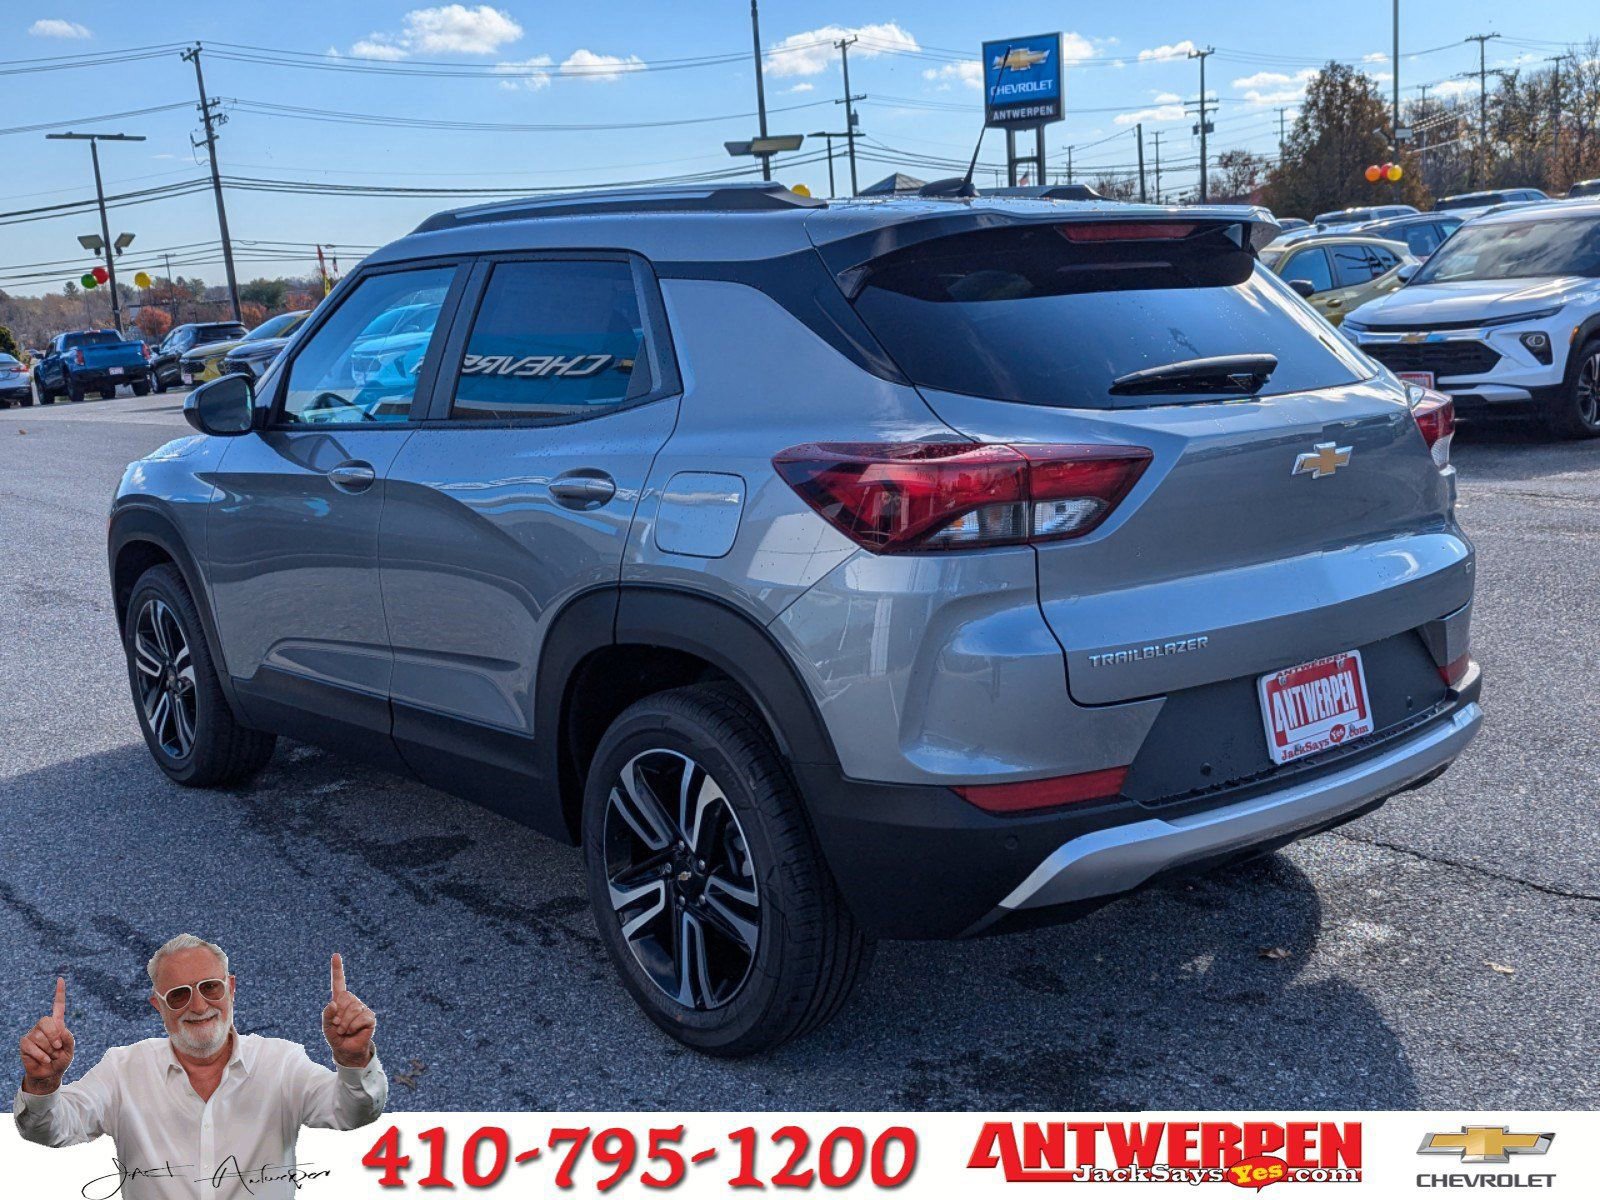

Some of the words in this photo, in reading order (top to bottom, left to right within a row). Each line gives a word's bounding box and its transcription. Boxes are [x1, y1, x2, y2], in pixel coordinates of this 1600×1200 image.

[990, 80, 1054, 96] CHEVROLET
[993, 105, 1054, 120] ANTWERPEN
[1088, 636, 1209, 668] TRAILBLAZER
[1272, 670, 1358, 732] ANTWERPEN
